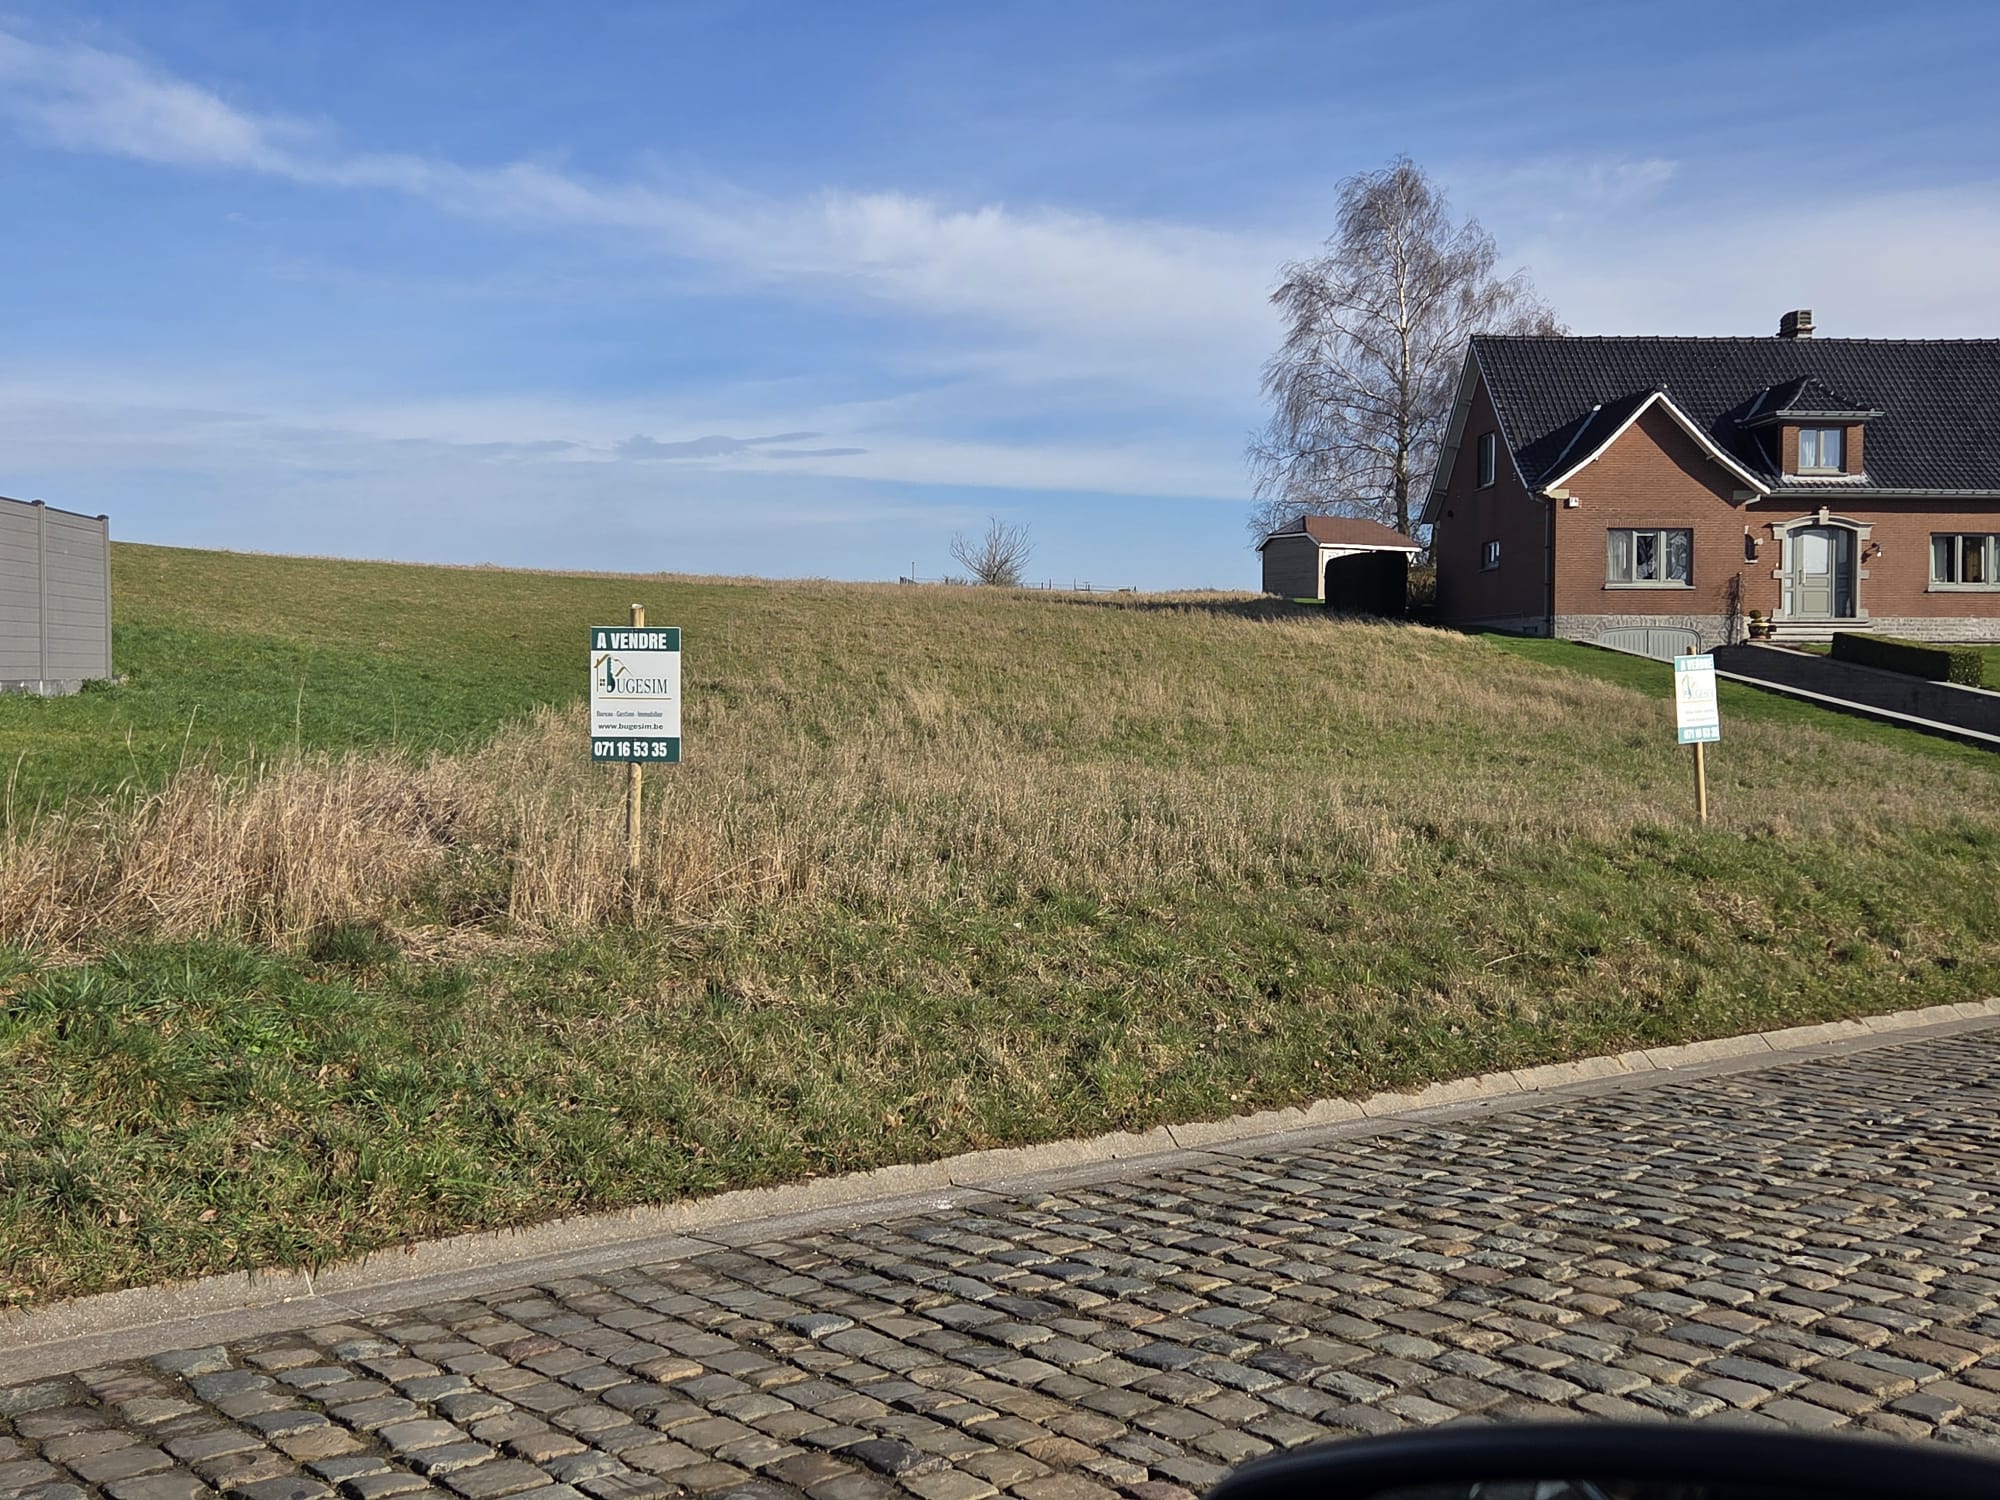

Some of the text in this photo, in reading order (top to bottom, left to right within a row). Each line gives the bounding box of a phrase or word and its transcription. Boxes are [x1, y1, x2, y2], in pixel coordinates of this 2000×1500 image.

[597, 632, 667, 649] A VENDRE
[598, 723, 664, 731] www.bugesim.be
[594, 741, 667, 757] 071 16 53 35
